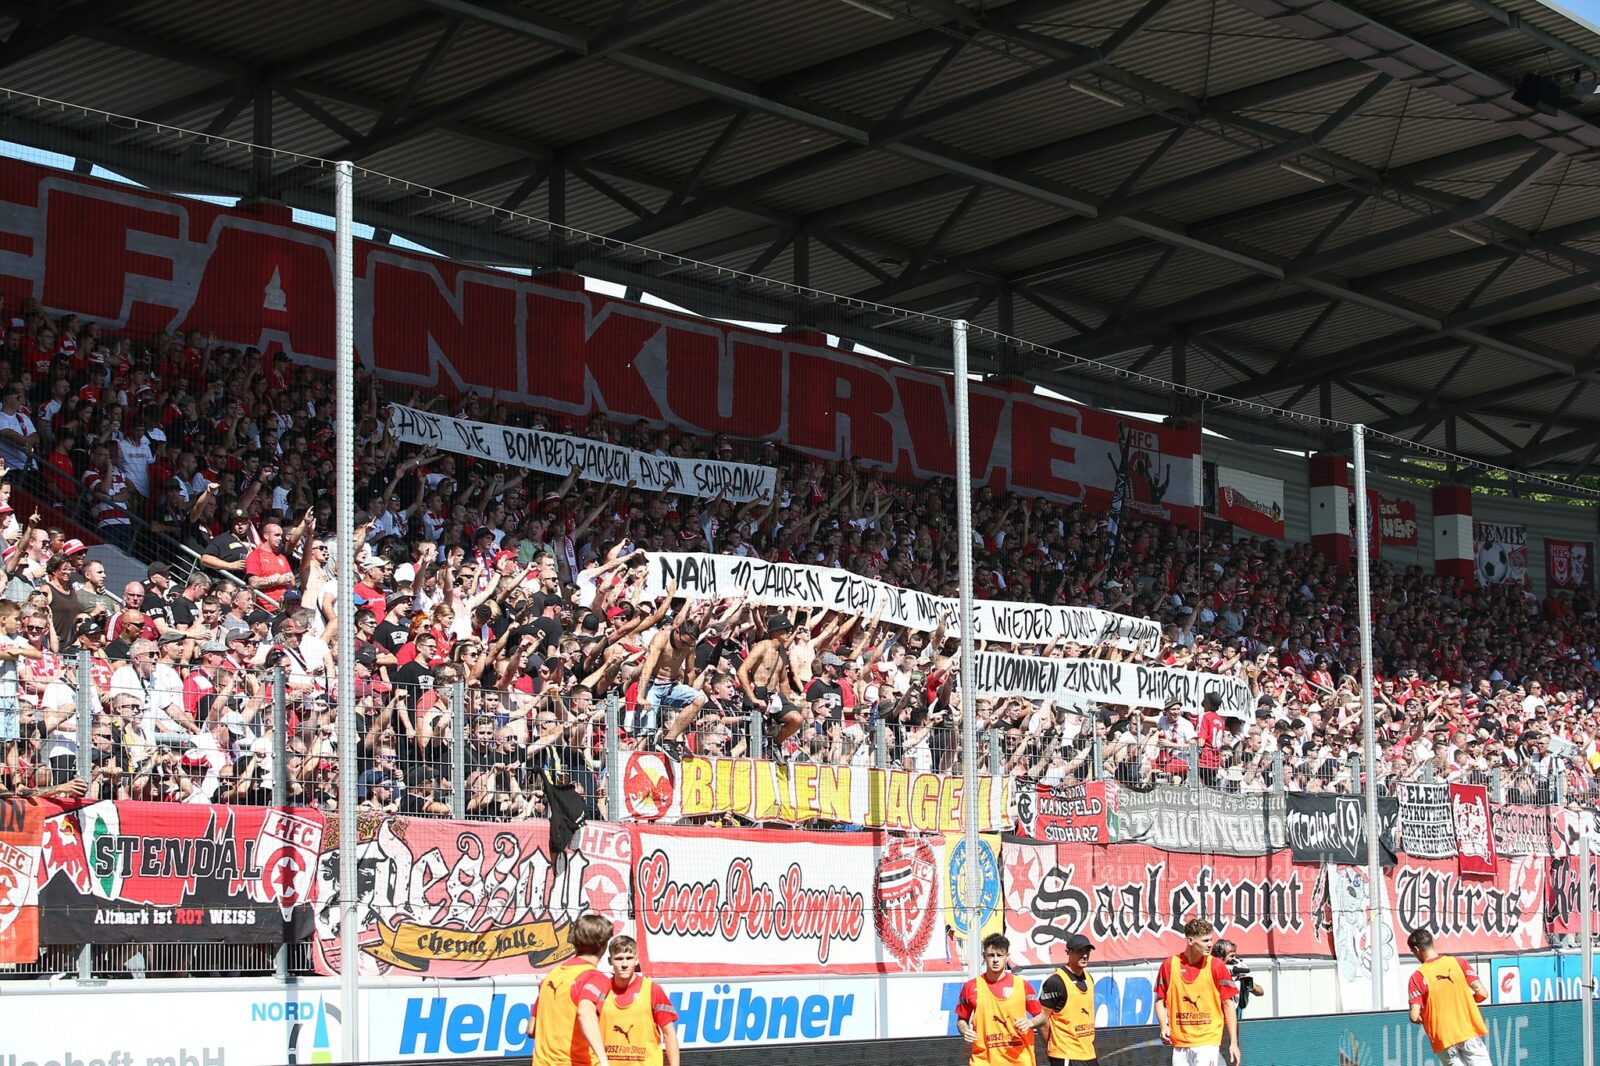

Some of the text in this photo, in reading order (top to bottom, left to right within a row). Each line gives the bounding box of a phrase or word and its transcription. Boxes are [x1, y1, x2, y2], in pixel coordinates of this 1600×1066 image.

[42, 182, 1084, 502] FANKURVE
[399, 412, 441, 440] HOLT
[1129, 431, 1153, 449] HFC
[660, 556, 717, 594] NACH
[752, 564, 824, 603] JAHREN
[1039, 796, 1103, 817] MANSFELD
[275, 817, 315, 847] HFC
[581, 827, 632, 858] HFC
[1044, 820, 1099, 842] SÜDHARZ
[94, 832, 263, 880] STENDAL
[94, 908, 256, 926] Altmark ist ROT WEISS
[639, 849, 720, 936] Coesa
[720, 856, 777, 942] Per
[775, 862, 864, 964] Sempre
[1031, 862, 1303, 945] Saalefront
[1398, 866, 1523, 938] Ultras
[252, 1002, 314, 1021] NORD
[399, 984, 855, 1056] Helg Hübner
